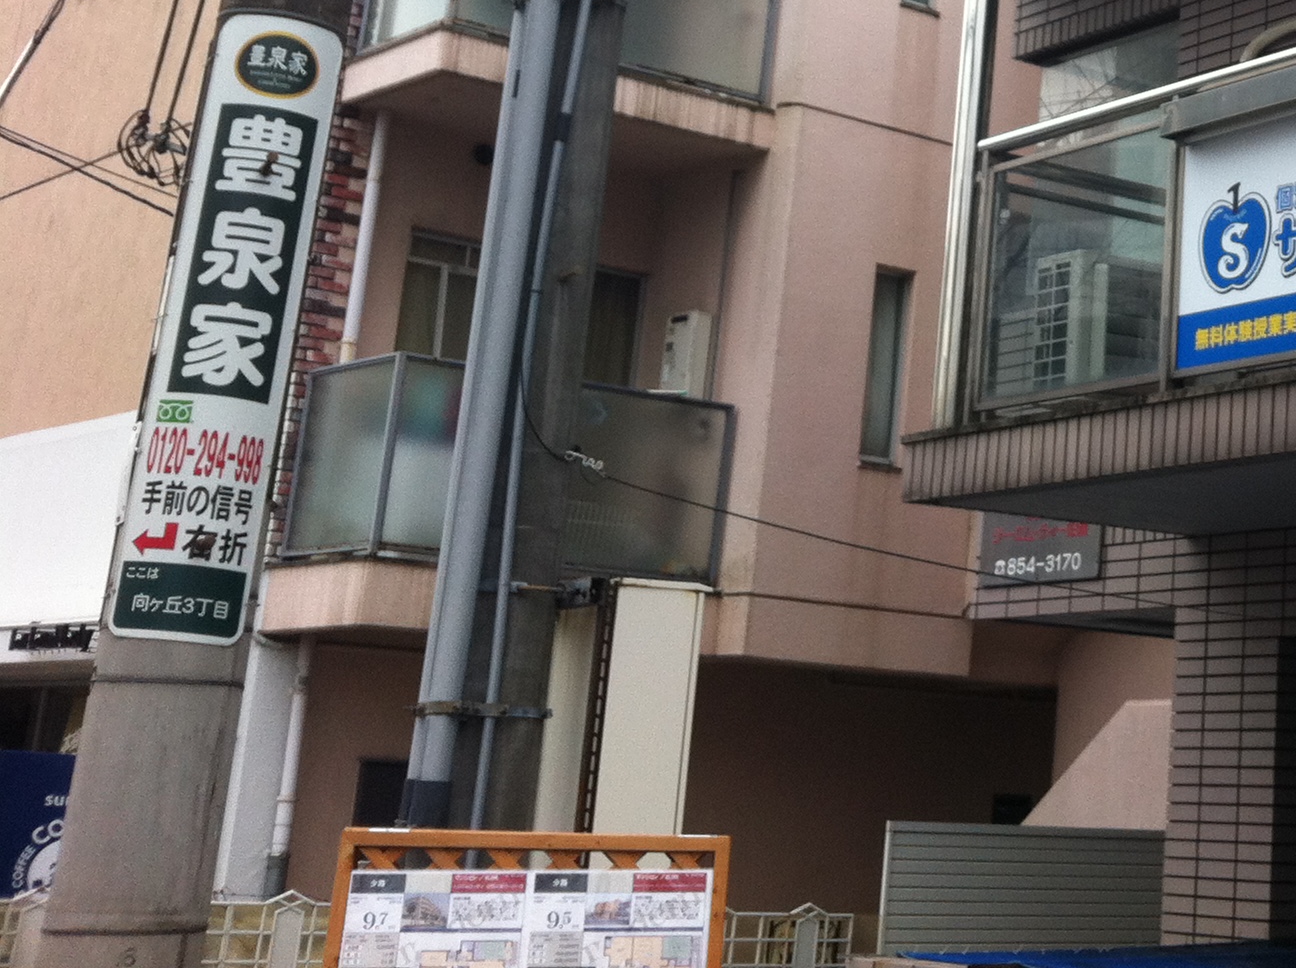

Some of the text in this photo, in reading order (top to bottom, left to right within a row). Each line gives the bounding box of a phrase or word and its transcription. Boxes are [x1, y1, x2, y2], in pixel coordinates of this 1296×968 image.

[247, 44, 308, 76] 豊泉家
[182, 114, 303, 386] 豊泉家
[146, 427, 264, 485] 0120-294-998
[141, 480, 253, 526] 手前の信号
[125, 566, 159, 580] ここは
[11, 844, 37, 889] COFFEE
